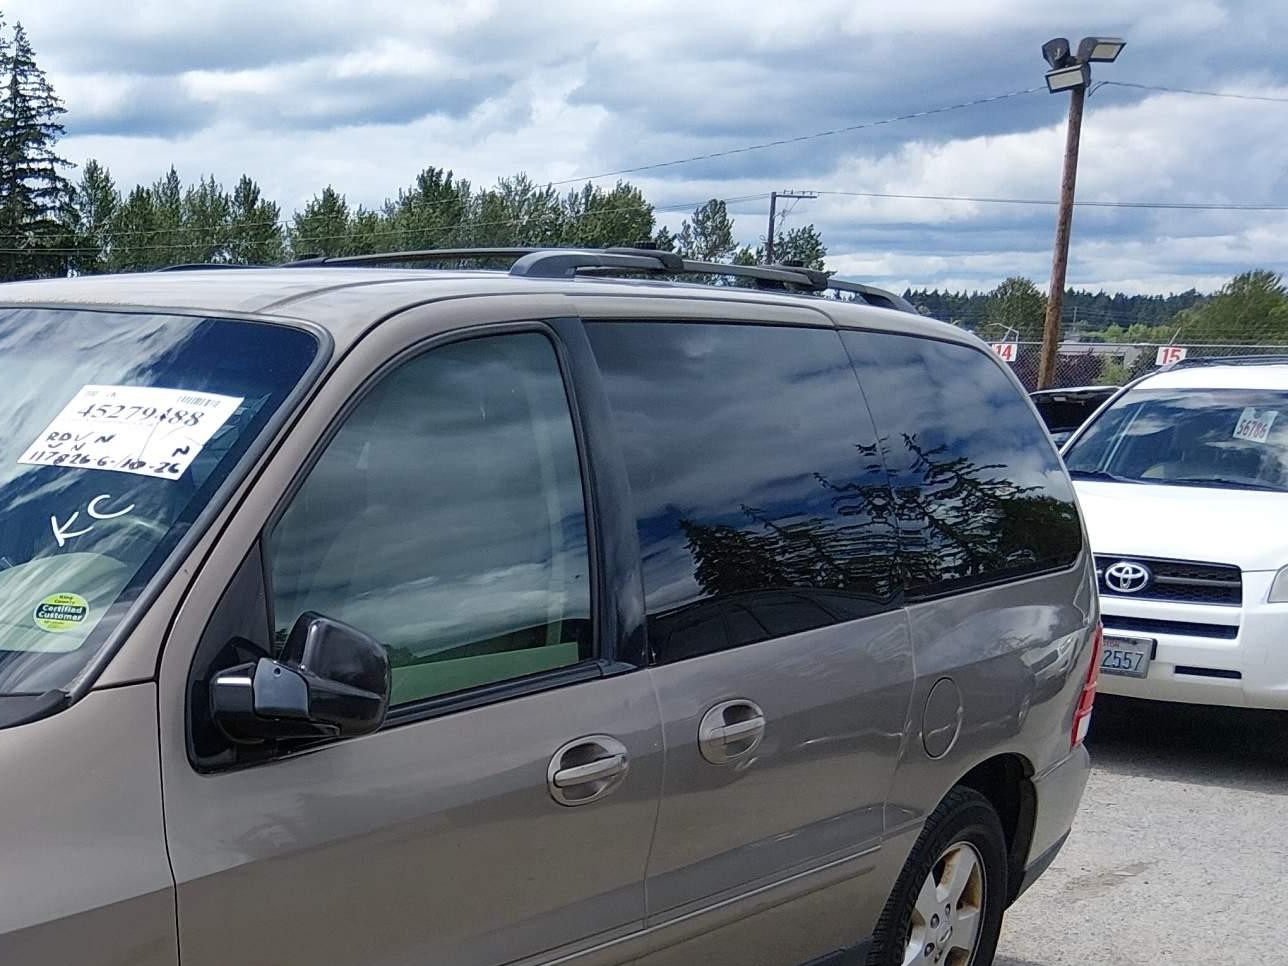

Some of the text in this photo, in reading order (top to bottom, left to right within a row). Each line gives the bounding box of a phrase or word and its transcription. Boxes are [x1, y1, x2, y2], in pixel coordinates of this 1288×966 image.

[996, 344, 1012, 361] 14
[1161, 348, 1182, 364] 15
[42, 604, 83, 614] Certified
[38, 611, 83, 621] Customer
